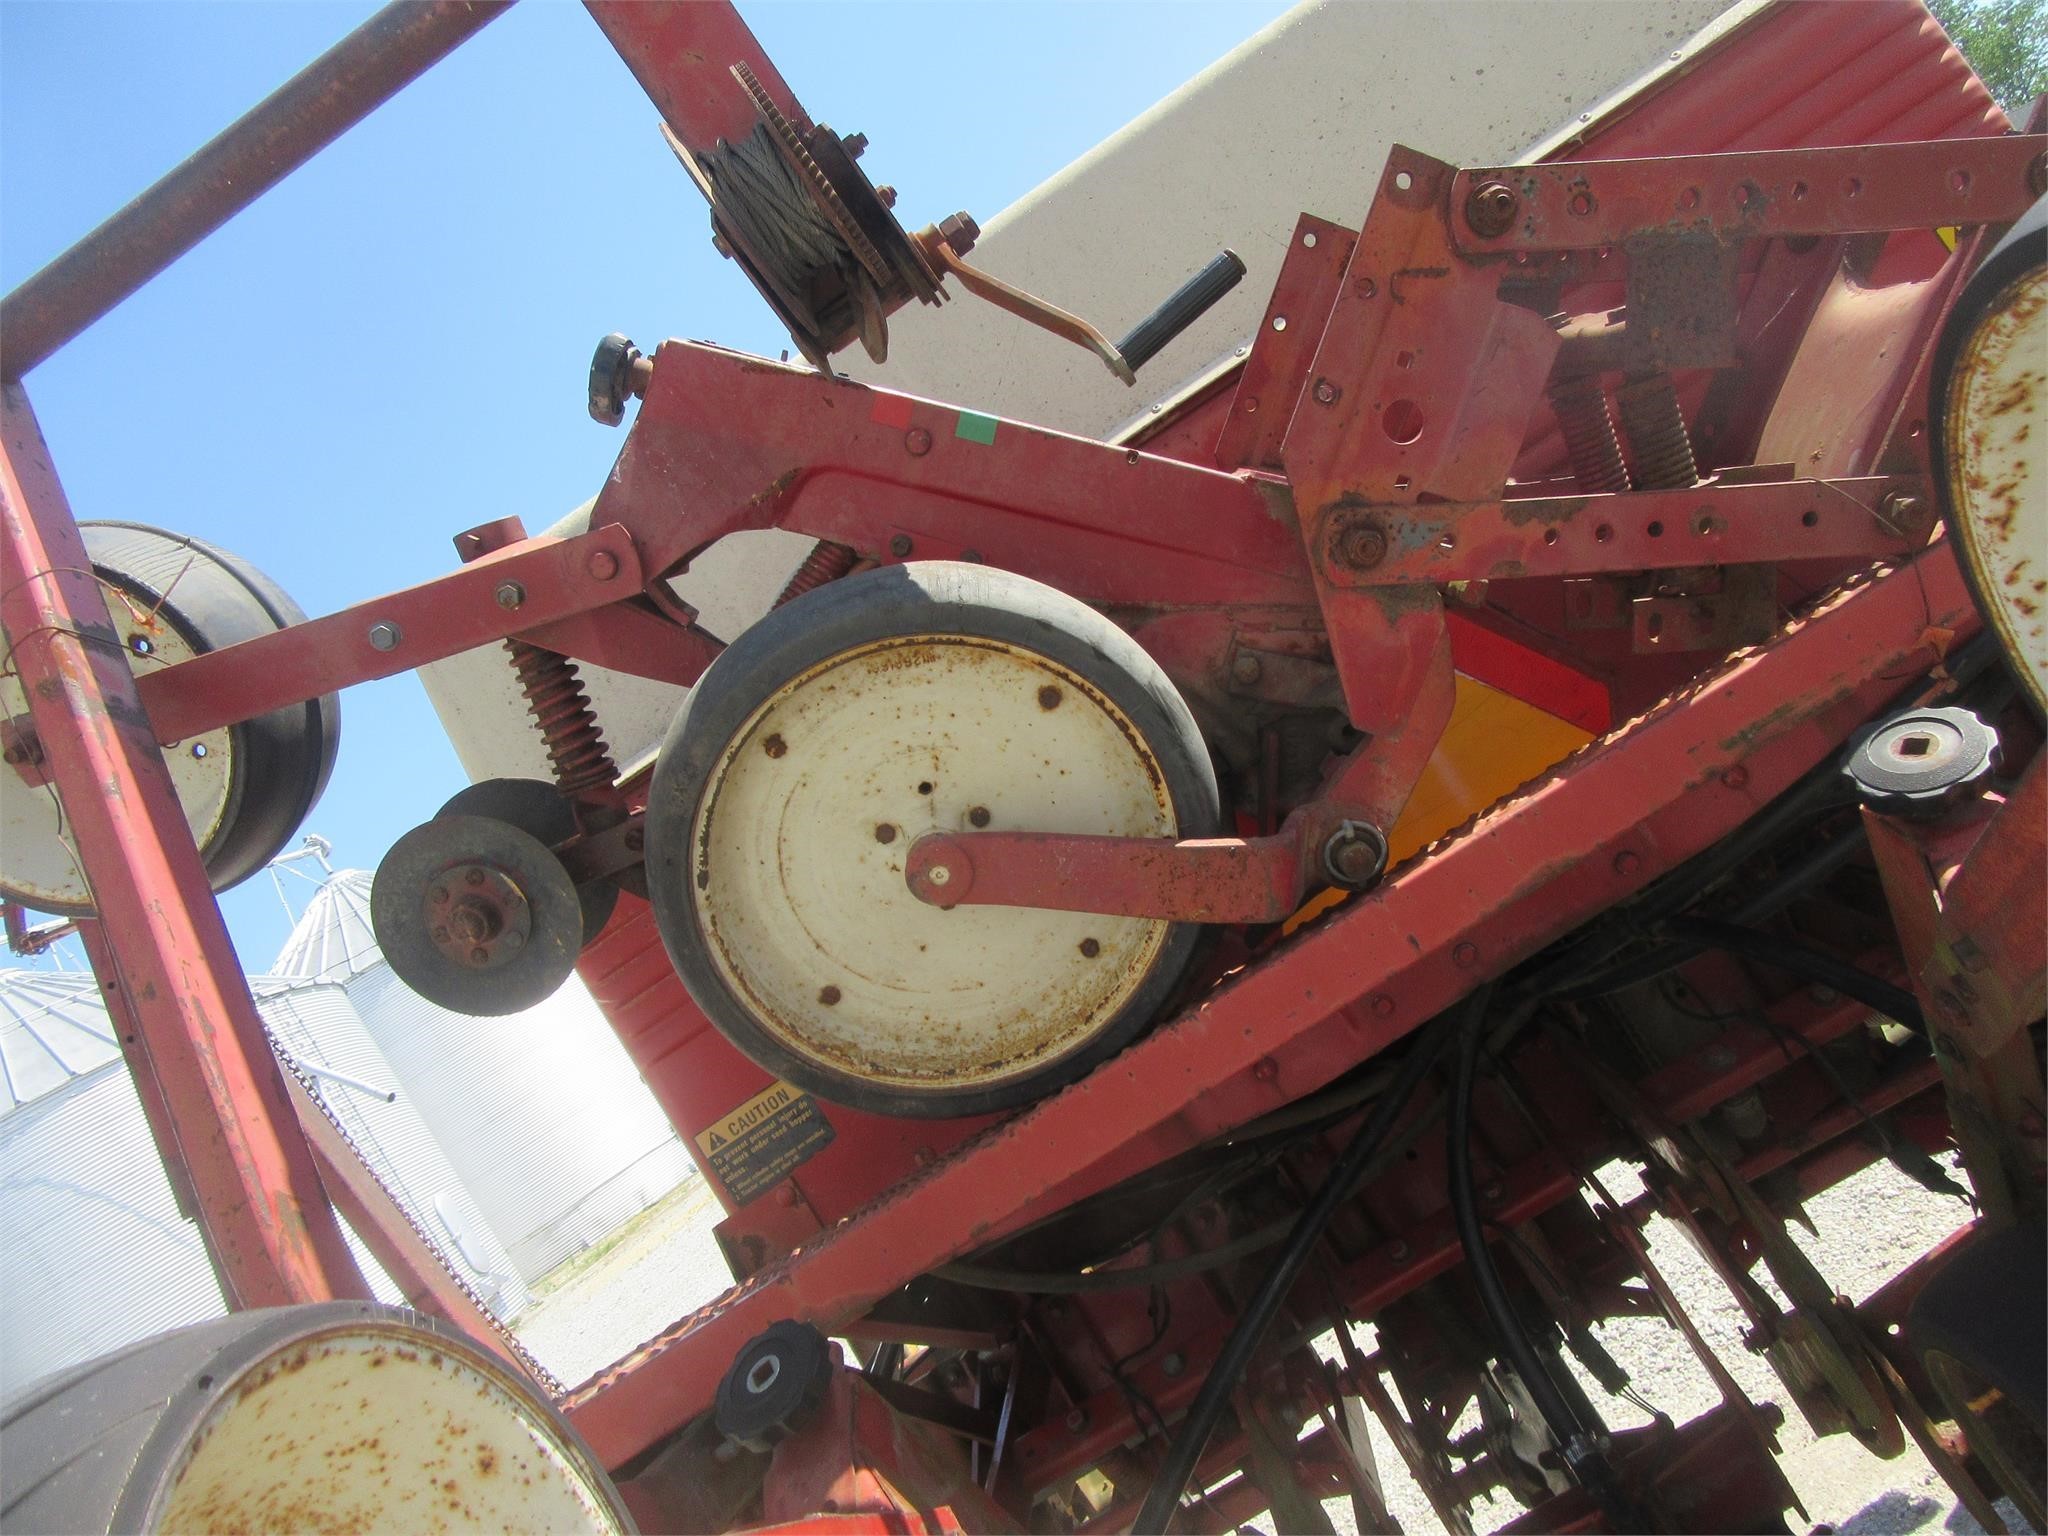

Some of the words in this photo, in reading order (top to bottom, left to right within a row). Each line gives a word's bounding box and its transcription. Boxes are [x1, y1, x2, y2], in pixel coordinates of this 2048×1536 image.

[728, 1088, 790, 1137] CAUTION
[713, 1158, 723, 1166] To
[723, 1139, 749, 1163] prevent
[749, 1119, 777, 1144] personal
[732, 1151, 749, 1166] work
[750, 1137, 769, 1153] under
